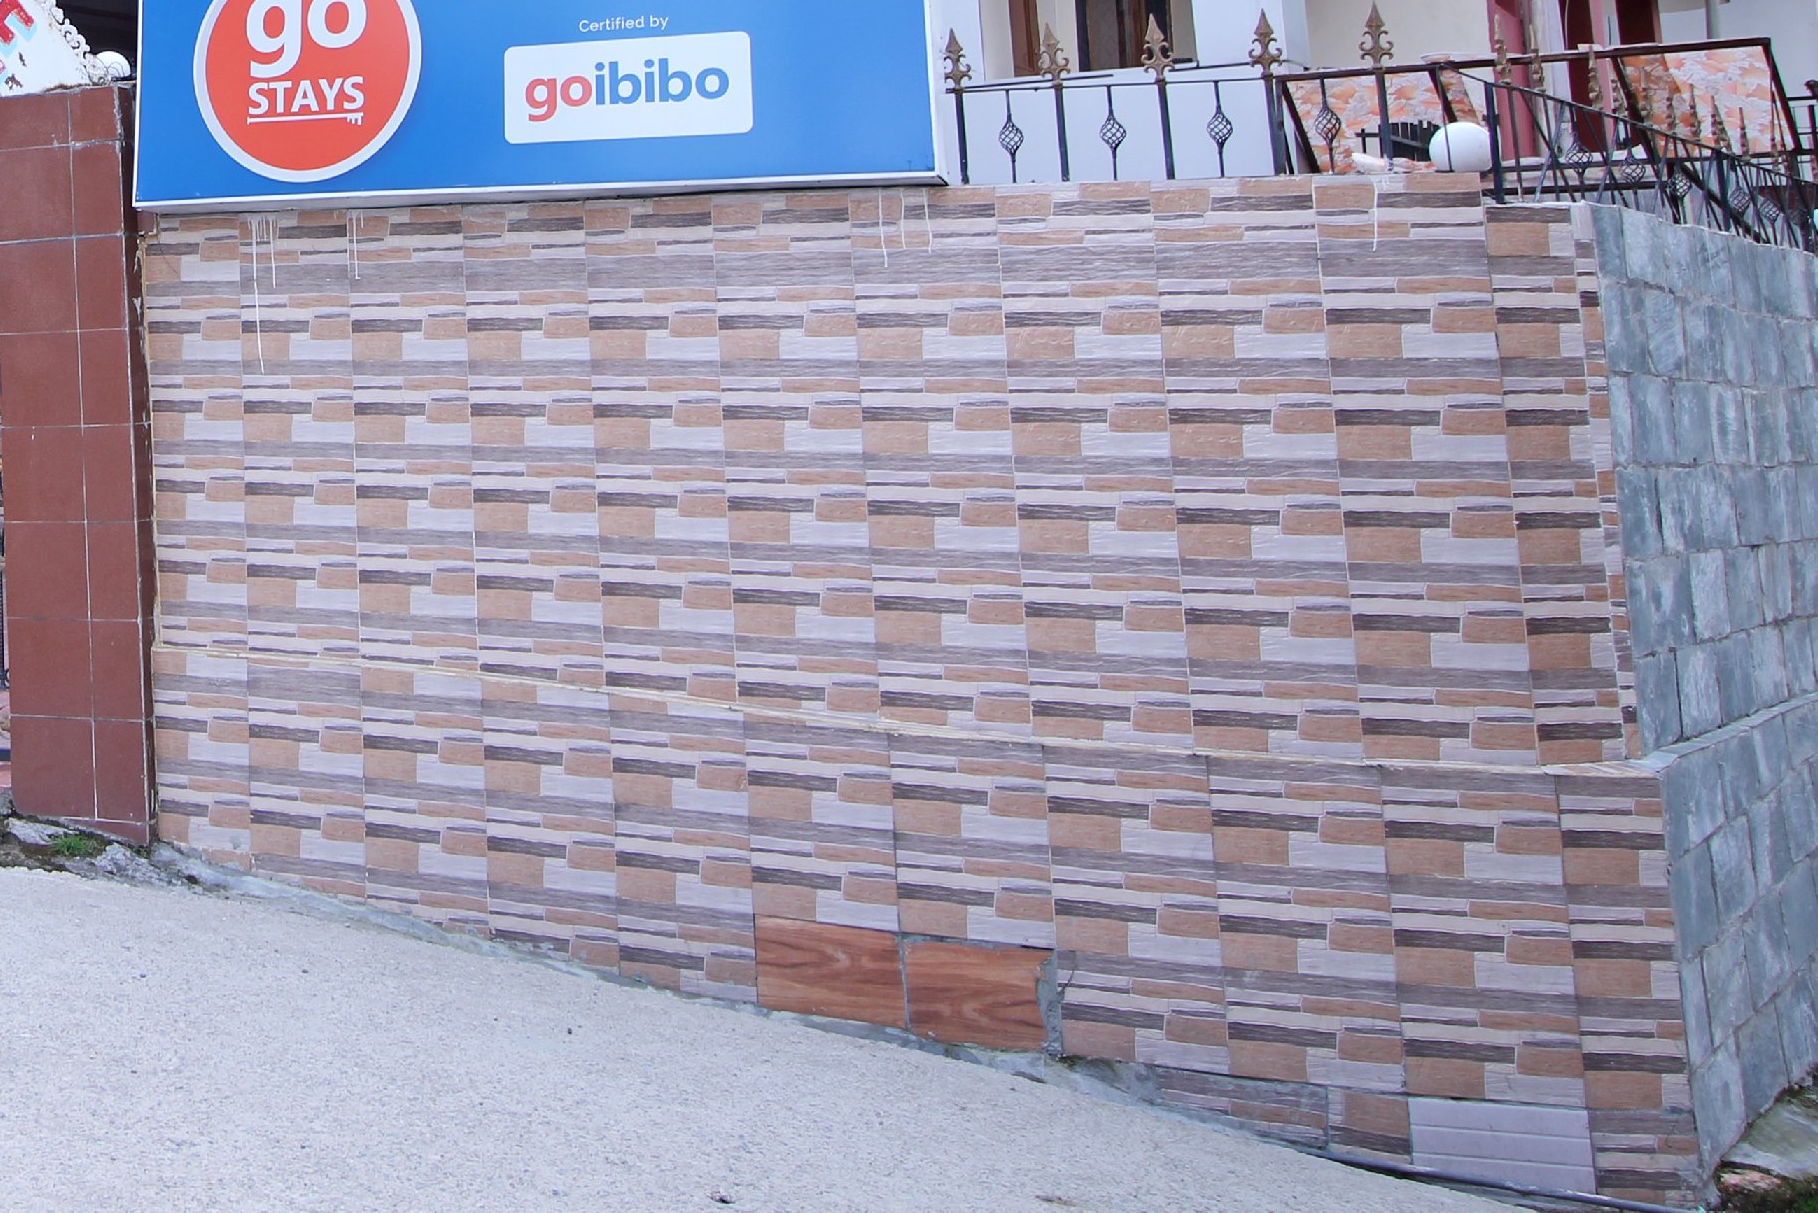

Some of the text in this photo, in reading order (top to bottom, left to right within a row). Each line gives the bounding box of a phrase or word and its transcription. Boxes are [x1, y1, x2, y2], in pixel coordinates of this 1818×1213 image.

[578, 14, 670, 33] Certified by
[247, 75, 365, 115] STAYS
[525, 57, 730, 123] goibibo
